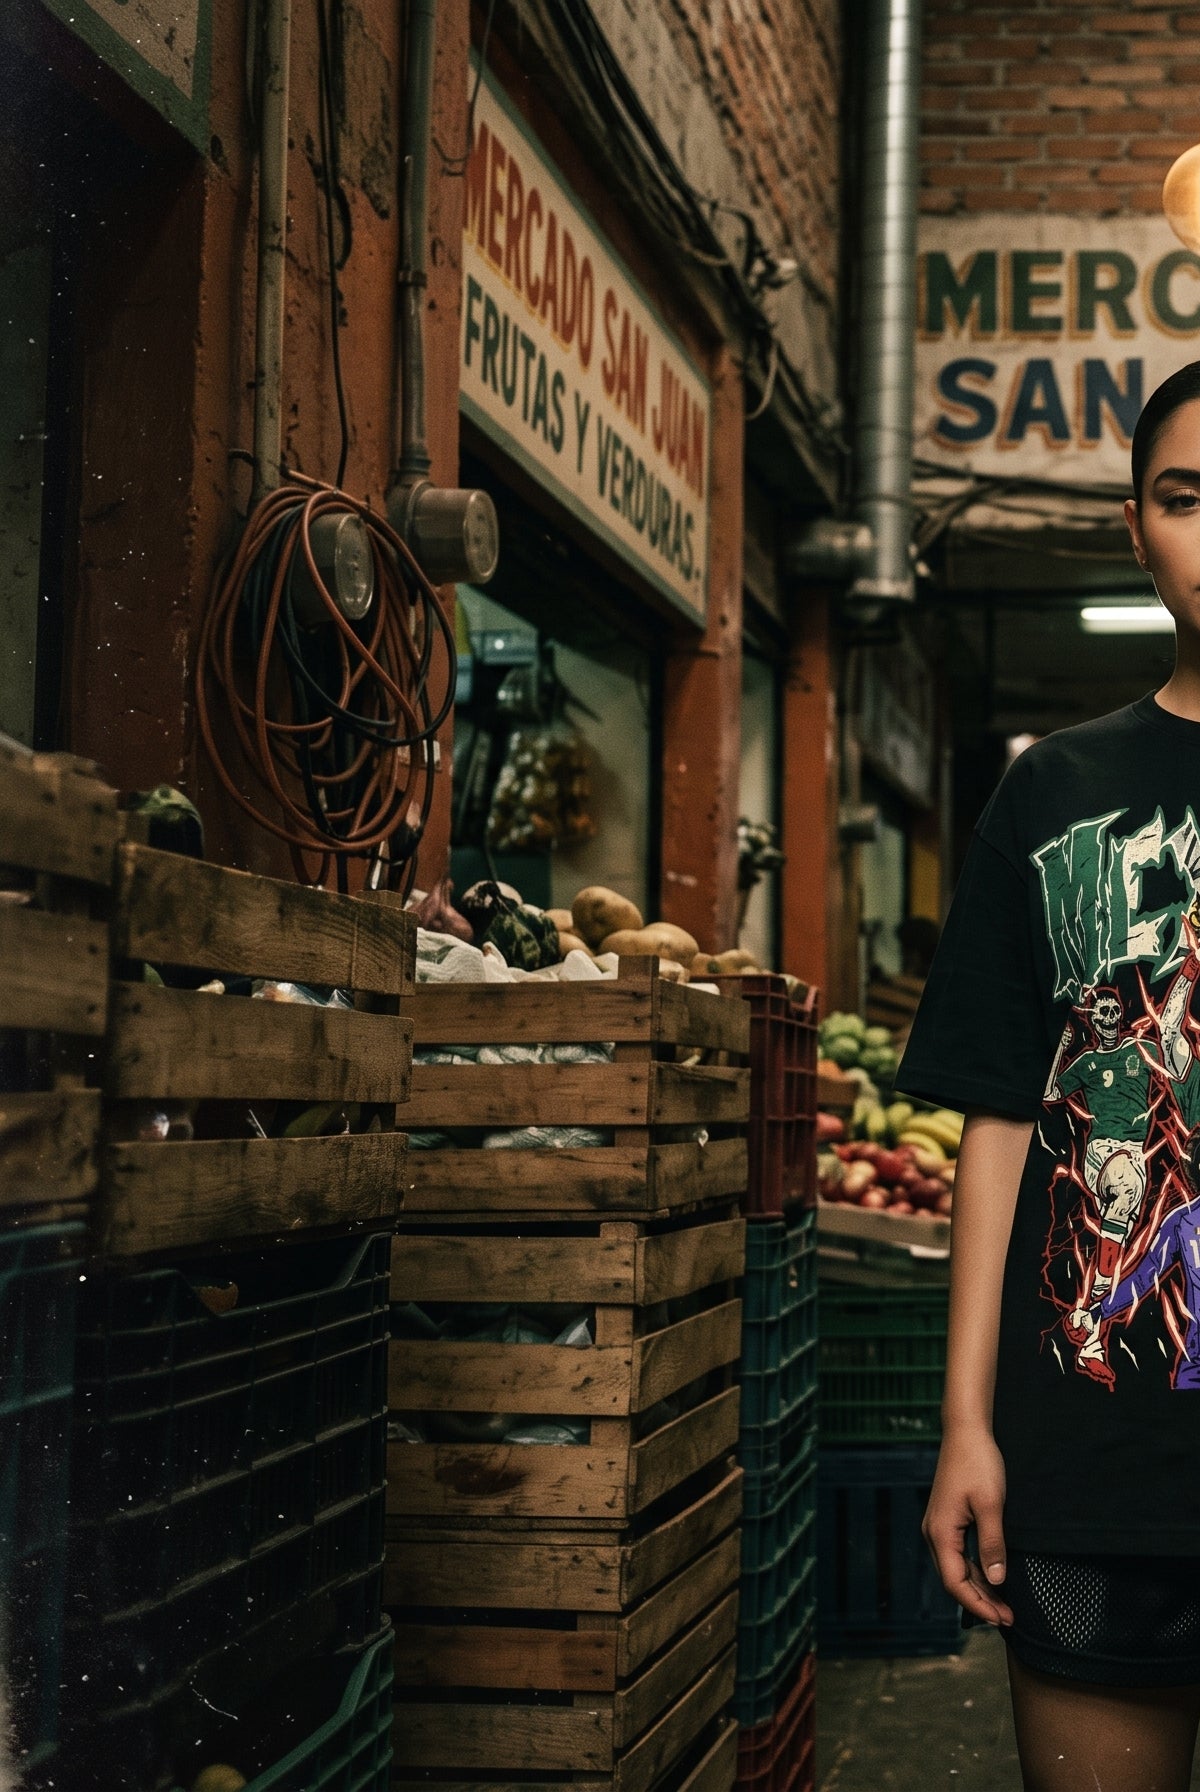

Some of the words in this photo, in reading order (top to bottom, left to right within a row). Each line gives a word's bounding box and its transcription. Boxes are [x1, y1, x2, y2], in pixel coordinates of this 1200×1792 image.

[462, 121, 594, 370] MERCADO
[602, 288, 648, 437] SAN
[652, 359, 705, 498] JUAN
[463, 273, 566, 455] FRUTAS
[574, 392, 590, 474] Y
[934, 356, 1144, 446] SAN
[1102, 1069, 1114, 1088] 9
